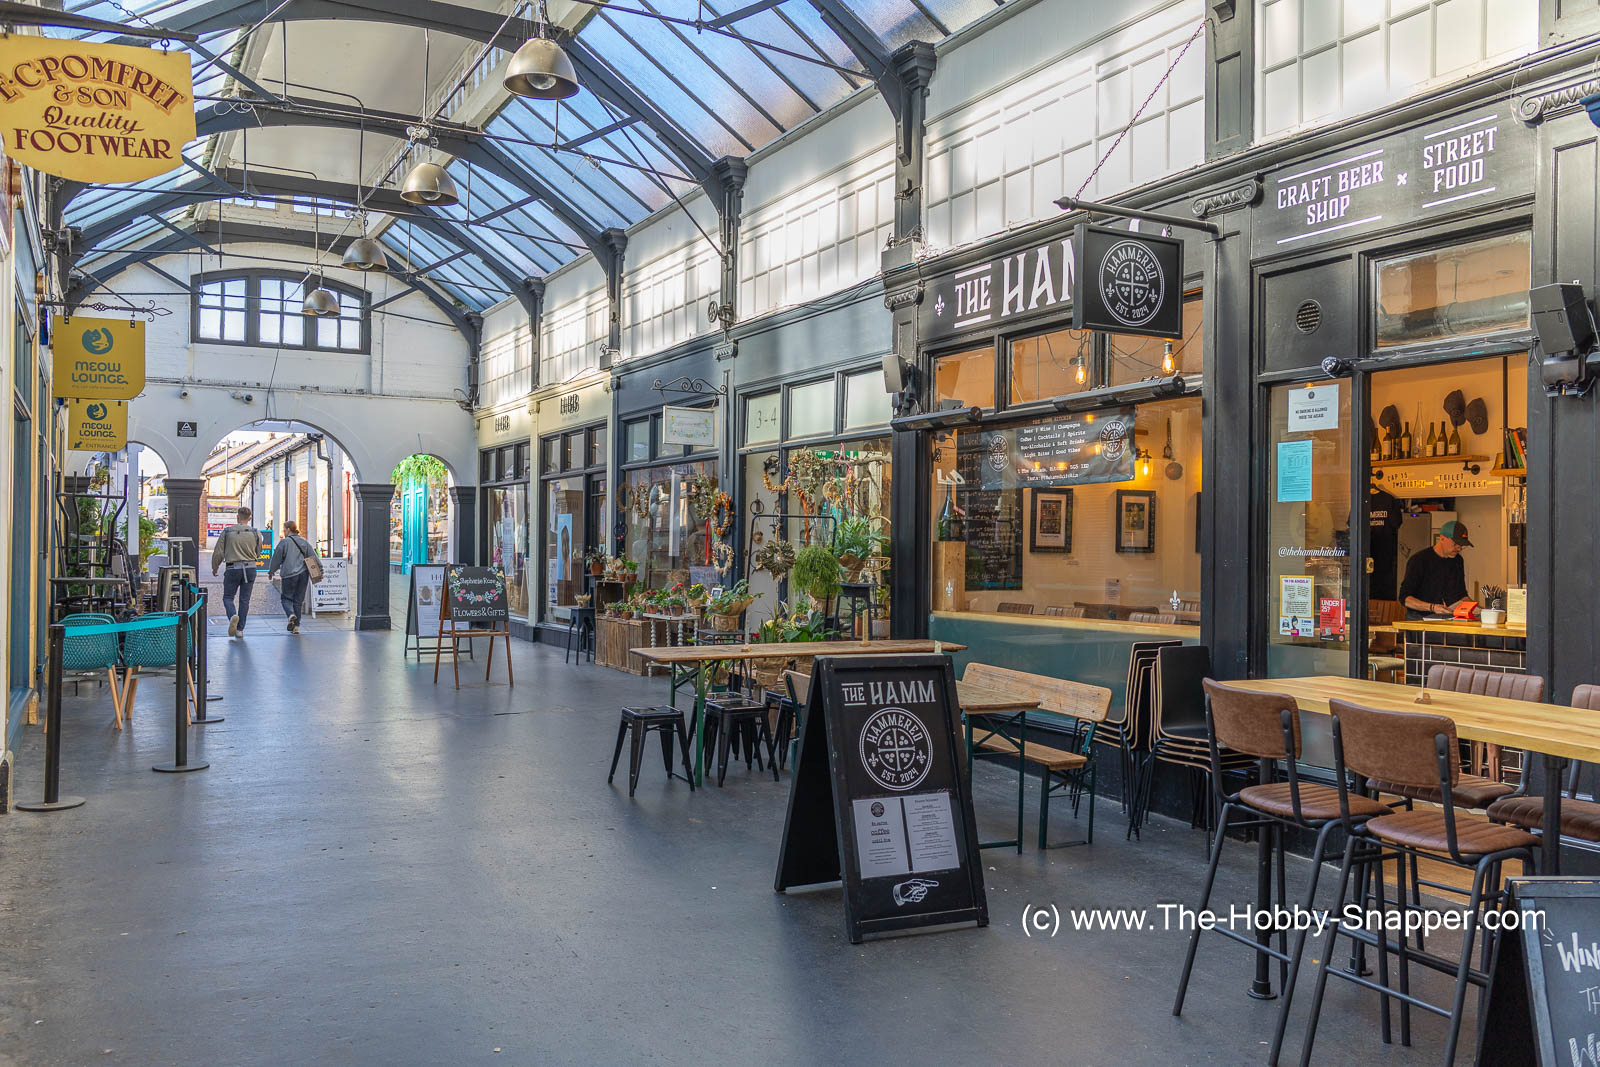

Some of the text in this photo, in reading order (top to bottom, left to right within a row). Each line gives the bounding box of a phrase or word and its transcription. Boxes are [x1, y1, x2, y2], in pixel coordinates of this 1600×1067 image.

[53, 85, 127, 107] & SON
[43, 106, 144, 135] Quality
[13, 128, 173, 160] FOOTWEAR
[1423, 126, 1498, 169] STREET
[1277, 160, 1384, 210] CRAFT BEER
[1433, 158, 1485, 193] FOOD
[1306, 194, 1351, 225] SHOP
[1107, 247, 1158, 280] HAMMERED
[955, 238, 1075, 318] THE HA
[1115, 302, 1150, 320] EST. 2024
[72, 373, 128, 385] LOUNGE
[75, 361, 121, 372] MEOW
[79, 430, 117, 438] LOUNGE
[81, 422, 112, 430] MEOW
[1278, 546, 1346, 558] @thehammhitchin
[1321, 599, 1340, 607] UNDER
[1321, 605, 1331, 613] 25?
[842, 680, 936, 705] THE HAMM
[866, 714, 922, 744] HAMMERED
[881, 767, 919, 784] EST. 2024
[1556, 932, 1600, 973] WIN
